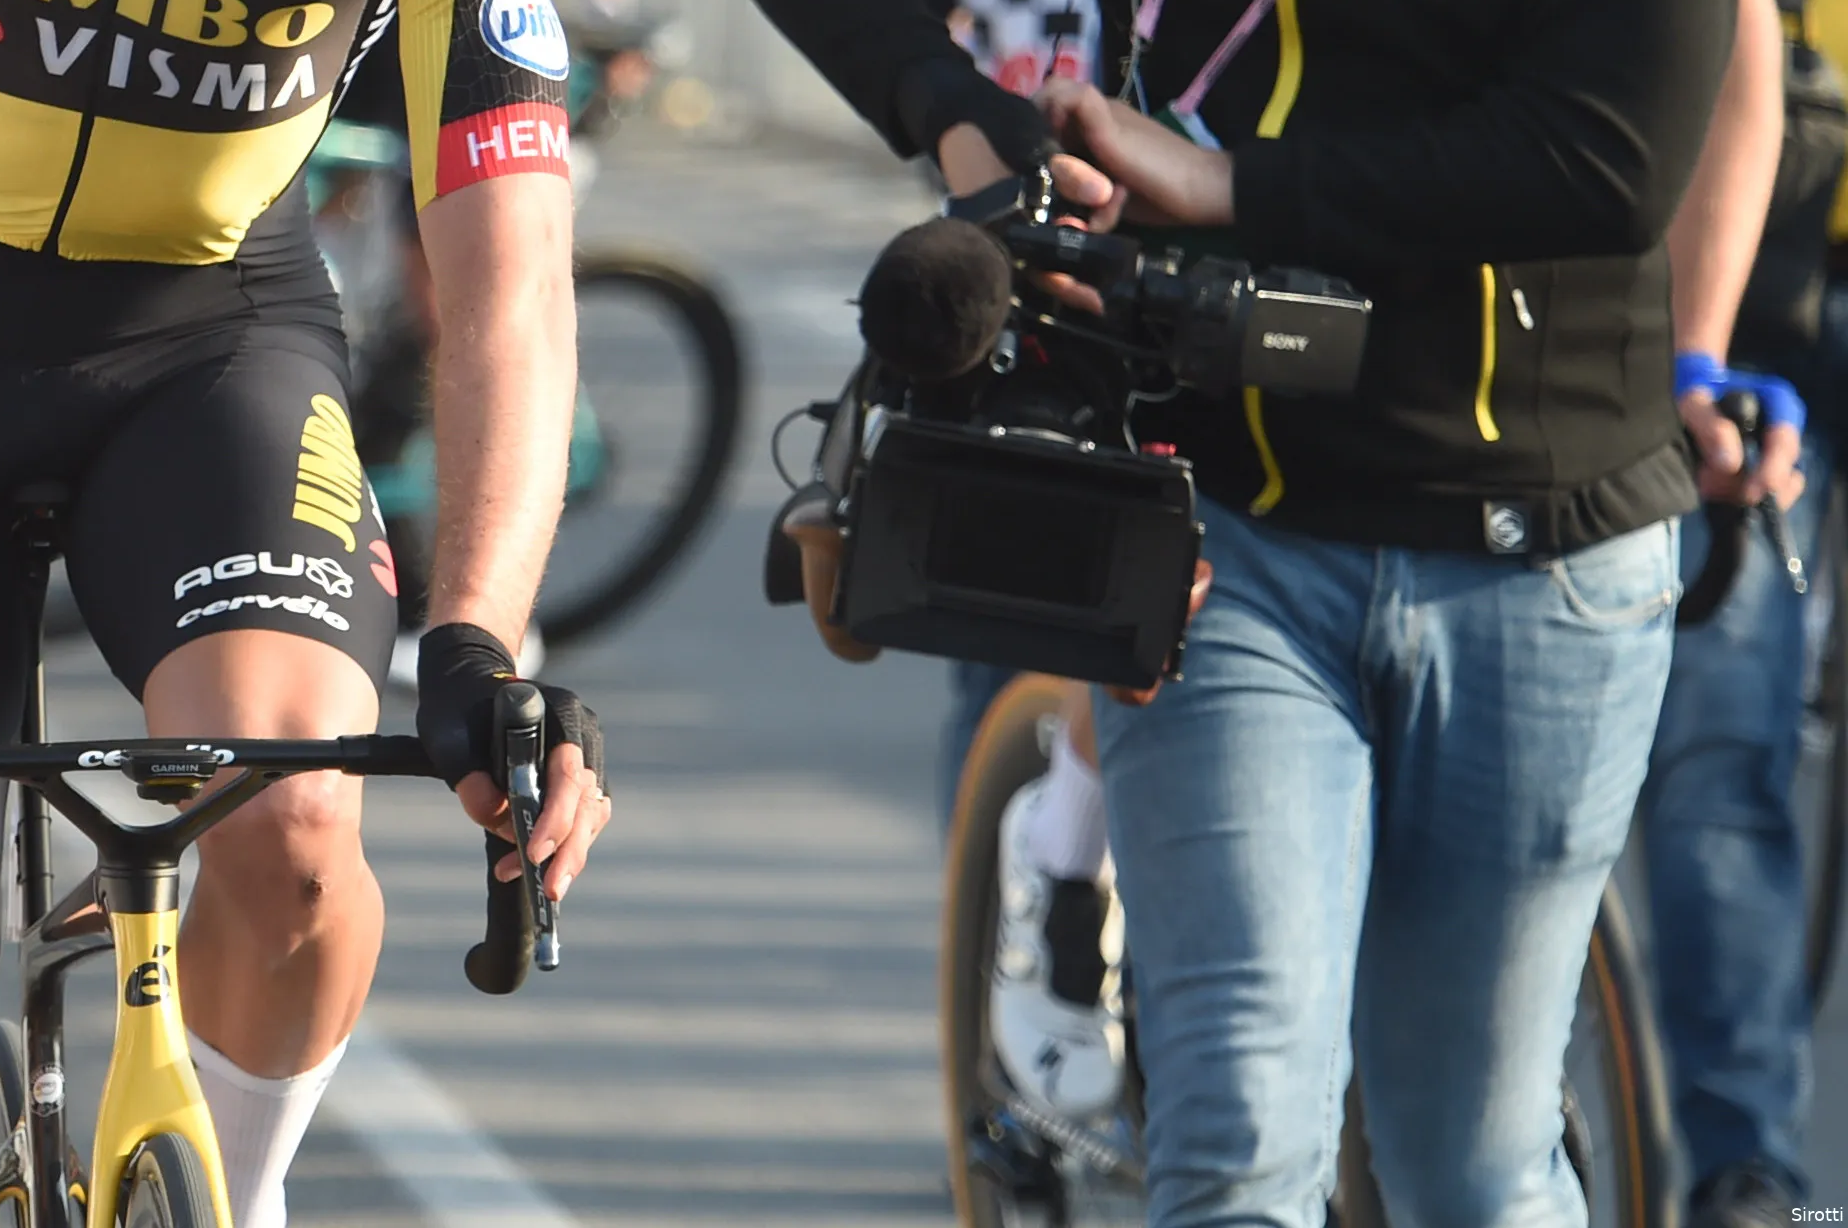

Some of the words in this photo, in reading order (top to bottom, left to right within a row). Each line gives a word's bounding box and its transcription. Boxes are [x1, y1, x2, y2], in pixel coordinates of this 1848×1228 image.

[35, 16, 317, 112] VISMA
[1262, 331, 1310, 352] SONY
[292, 393, 362, 553] JUMBO
[174, 551, 305, 600] AGU
[151, 763, 199, 773] GARMIN
